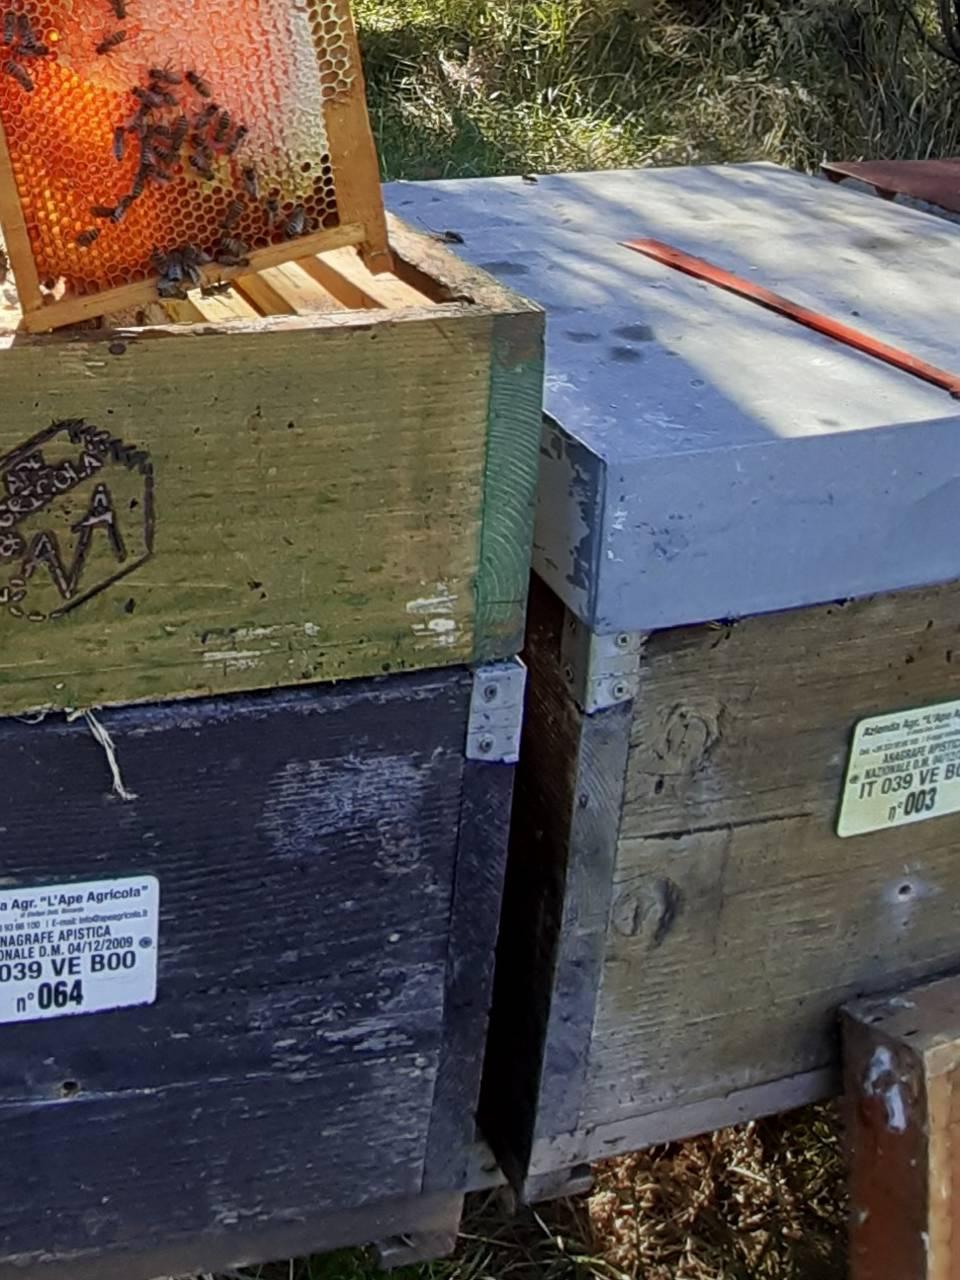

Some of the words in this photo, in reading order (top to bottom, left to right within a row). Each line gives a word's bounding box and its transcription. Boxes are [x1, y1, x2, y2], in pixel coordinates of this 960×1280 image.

[859, 781, 878, 799] IT
[881, 773, 914, 794] 039
[919, 766, 940, 785] VE
[11, 897, 36, 910] Agr.
[87, 885, 148, 903] Agricola"
[58, 925, 111, 941] APISTICA
[39, 943, 64, 957] D.M.
[68, 936, 133, 954] 04/12/2009
[52, 957, 81, 976] VE
